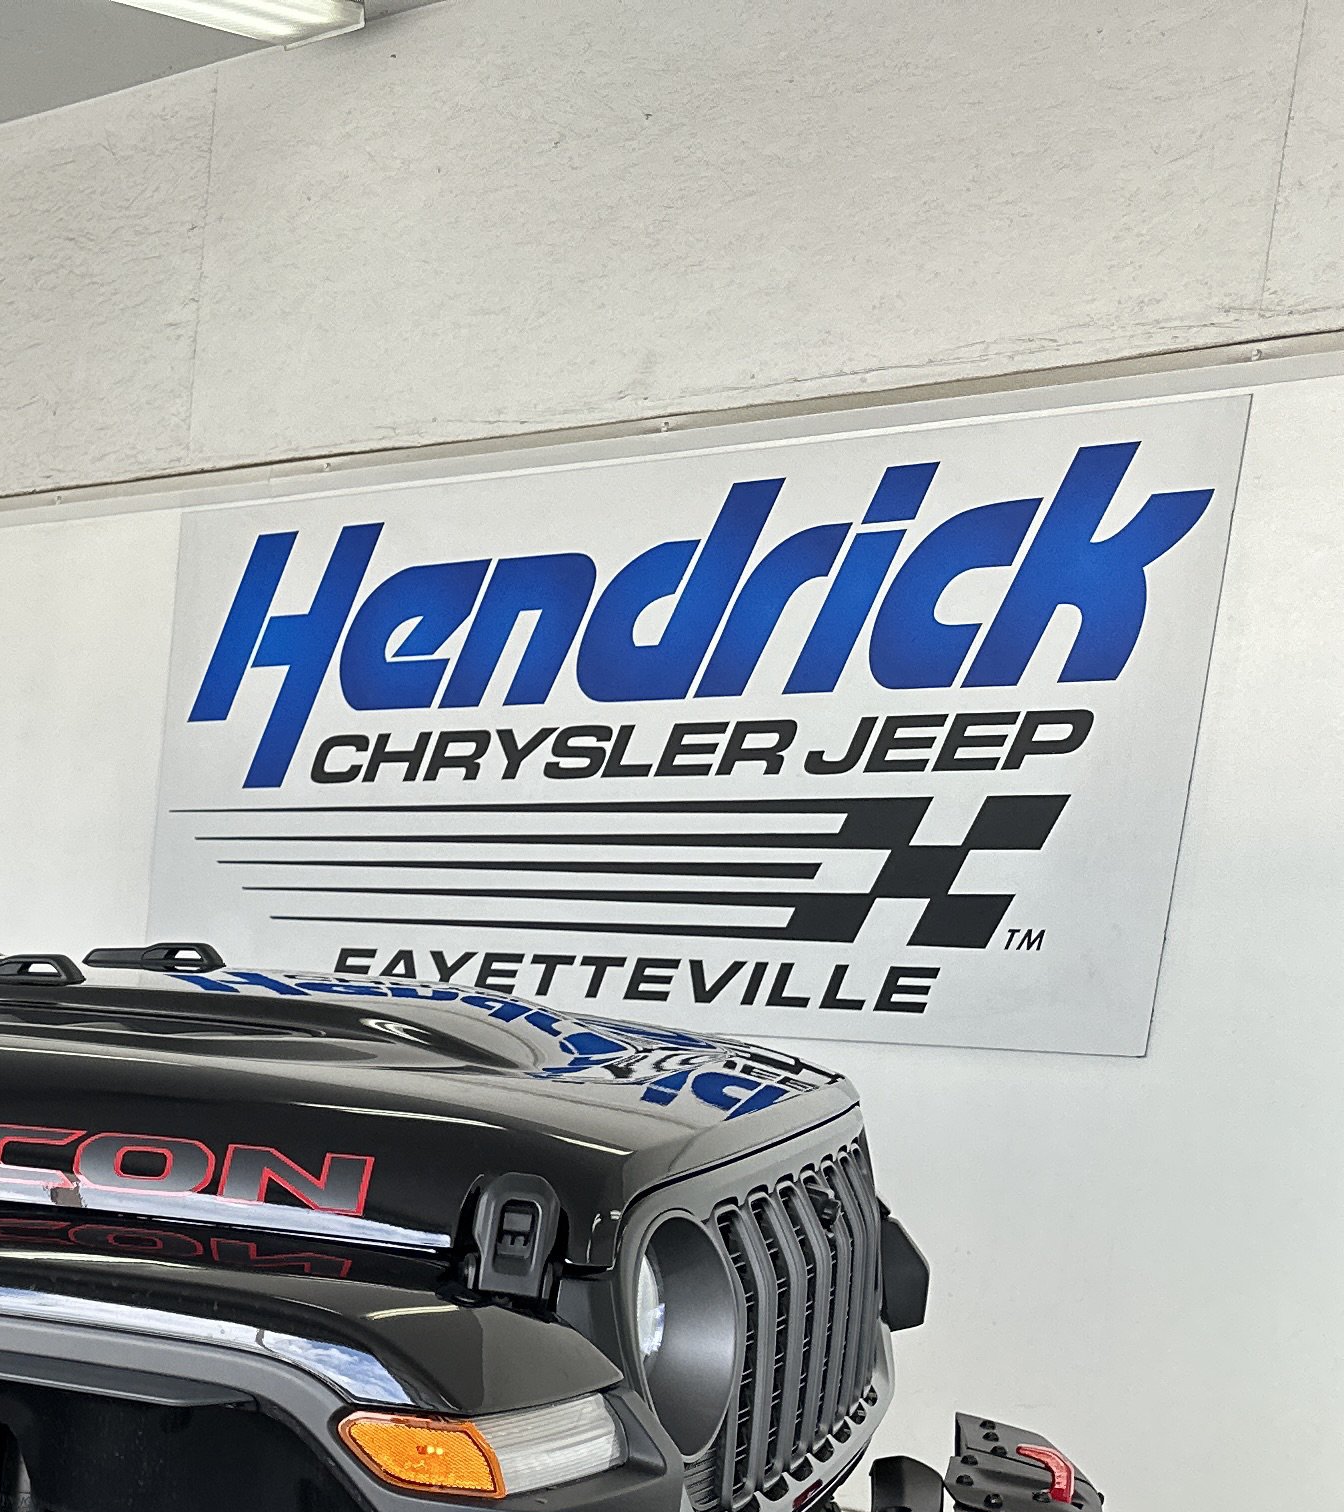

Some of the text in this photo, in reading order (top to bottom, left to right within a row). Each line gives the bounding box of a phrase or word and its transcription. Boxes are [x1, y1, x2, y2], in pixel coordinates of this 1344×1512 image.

[187, 439, 1216, 789] Hendrick
[310, 708, 1095, 784] CHRYSLER JEEP
[1004, 927, 1047, 952] TM
[333, 946, 942, 1014] FAYETTEVILLE
